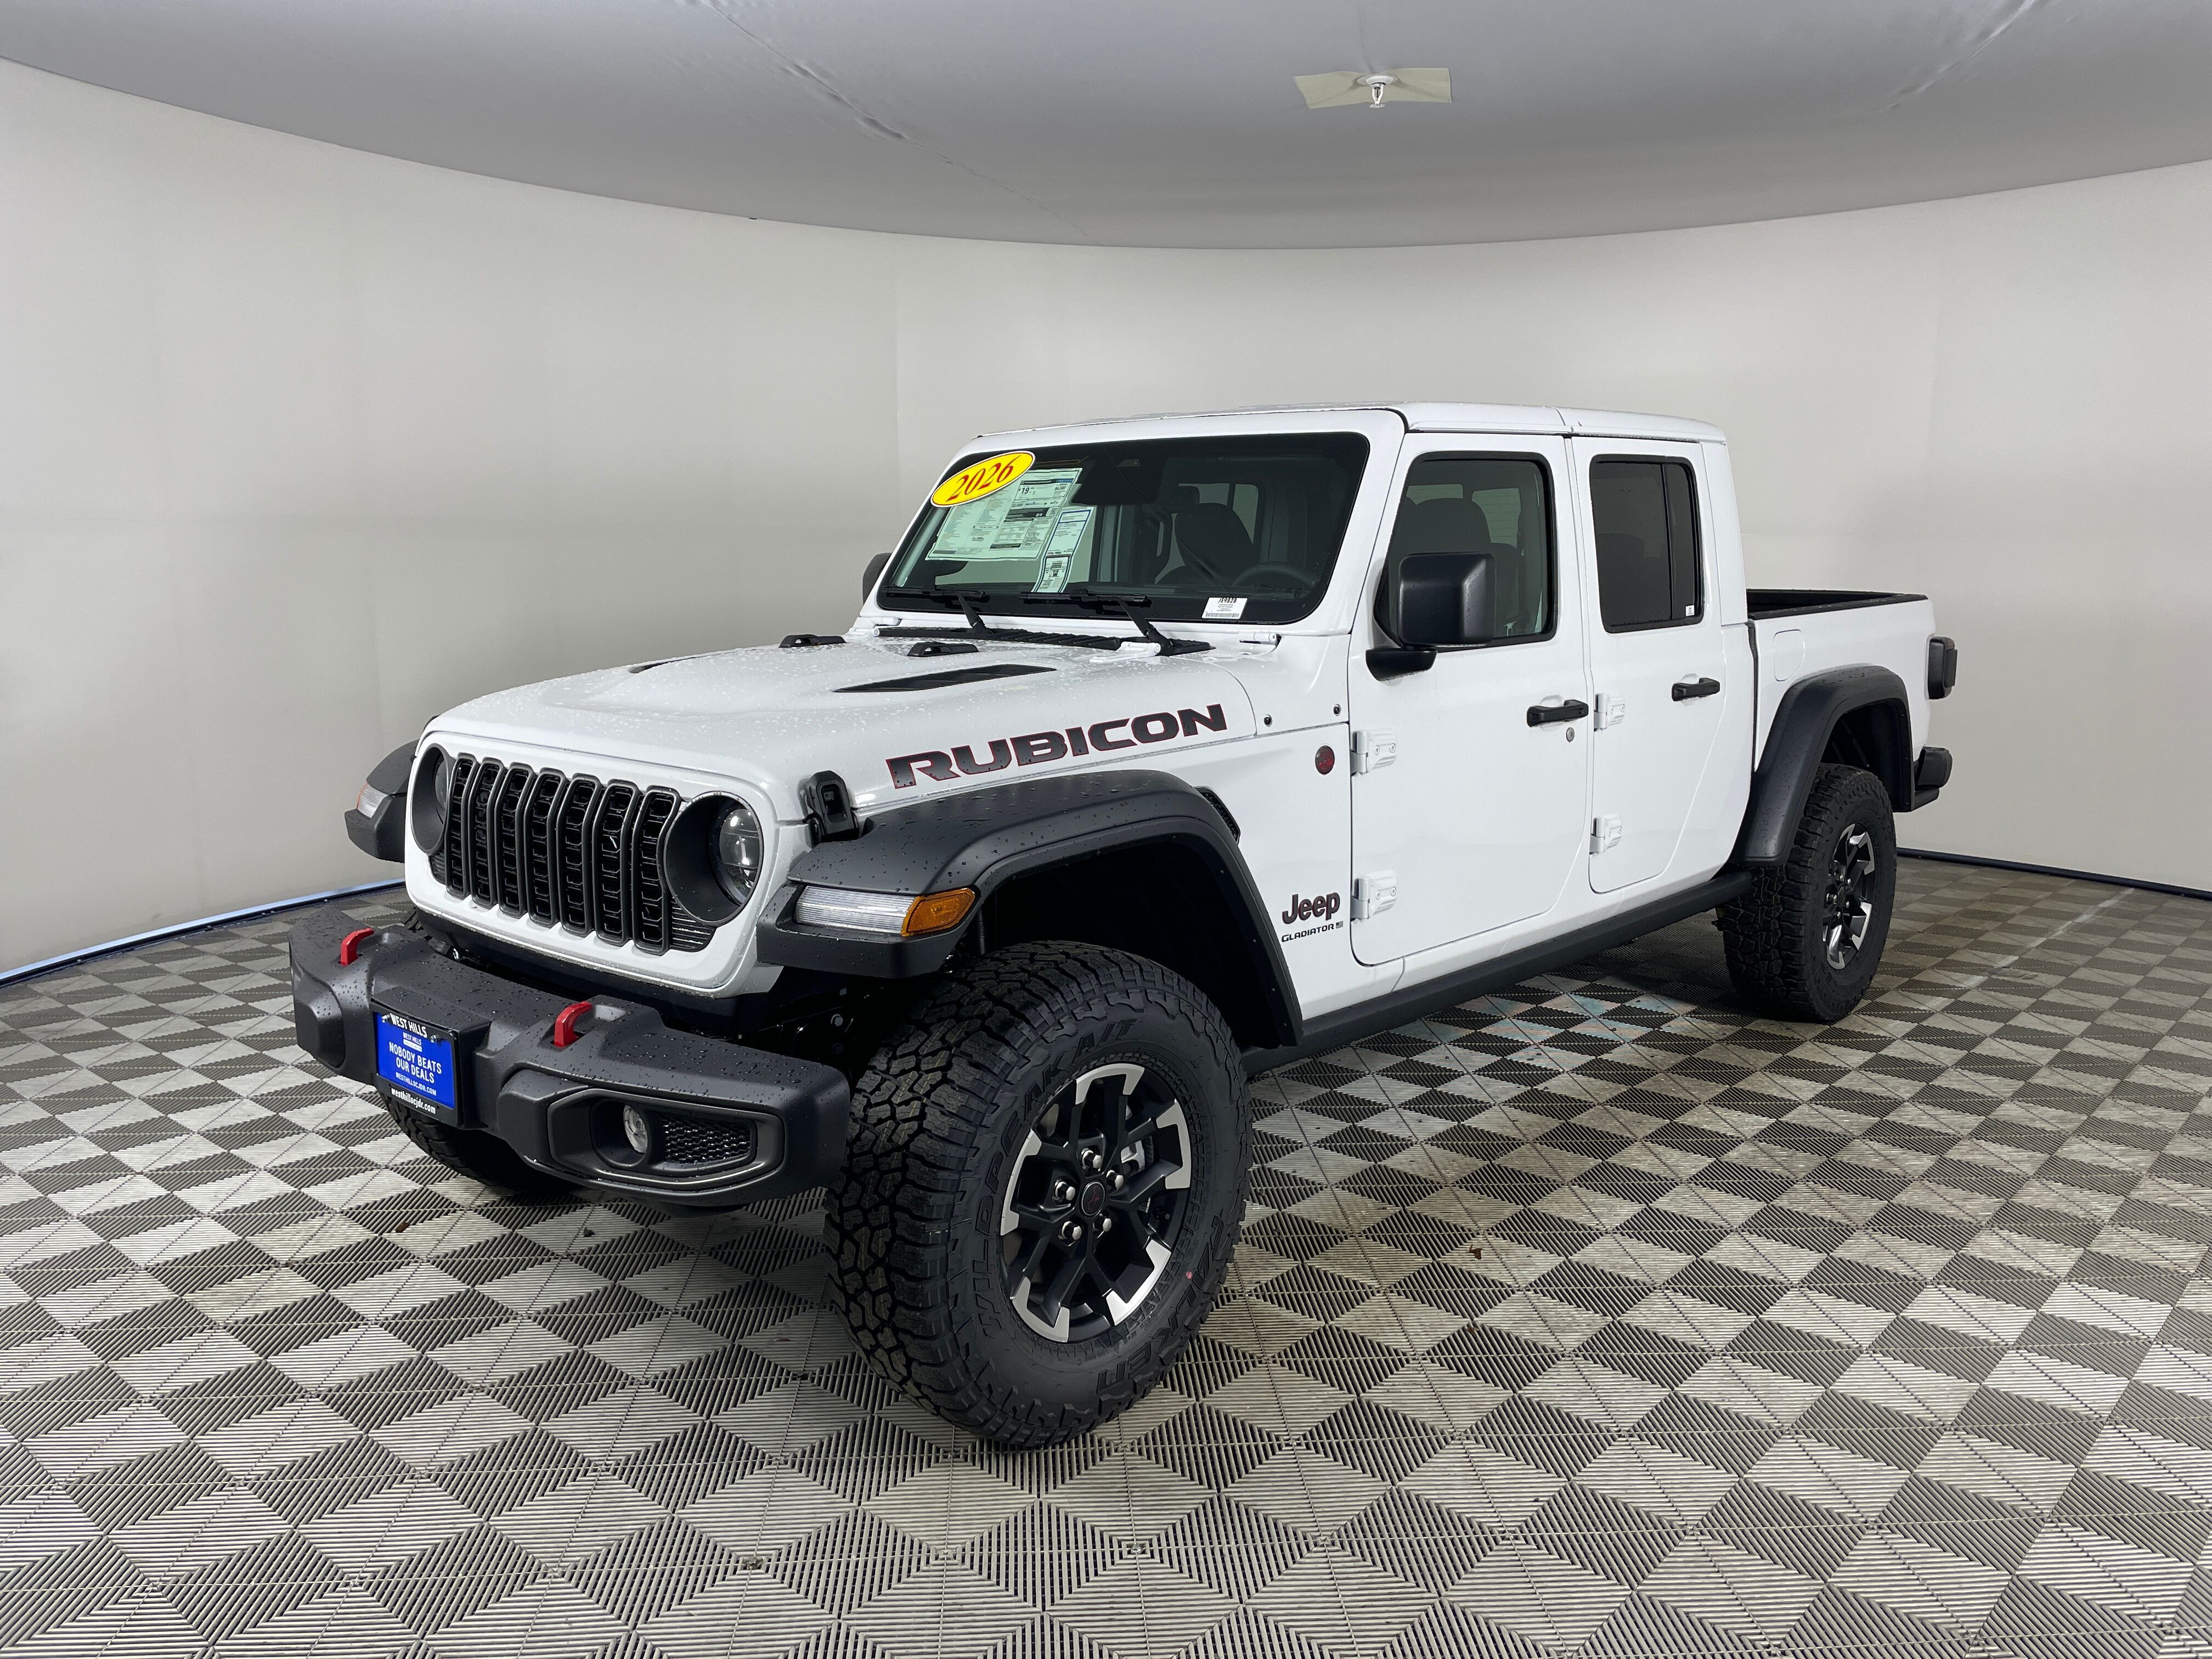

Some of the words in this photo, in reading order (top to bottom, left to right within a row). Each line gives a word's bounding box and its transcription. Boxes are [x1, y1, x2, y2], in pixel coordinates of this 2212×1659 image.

[945, 455, 1022, 503] 2026
[885, 703, 1227, 789] RUBICON
[1282, 892, 1340, 924] Jeep
[1282, 923, 1334, 943] GLADIATOR
[390, 1013, 407, 1029] WEST
[408, 1021, 427, 1038] HILLS
[403, 1031, 411, 1041] WEST
[412, 1036, 422, 1046] HILLS
[389, 1041, 415, 1063] NOBODY
[417, 1055, 442, 1074] BEATS
[396, 1057, 410, 1073] OUR
[411, 1064, 435, 1084] DEALS
[391, 1087, 436, 1114] westhillscjdr.com
[972, 1051, 1066, 1338] WILDPEAK
[1096, 1212, 1224, 1393] FALKEN
